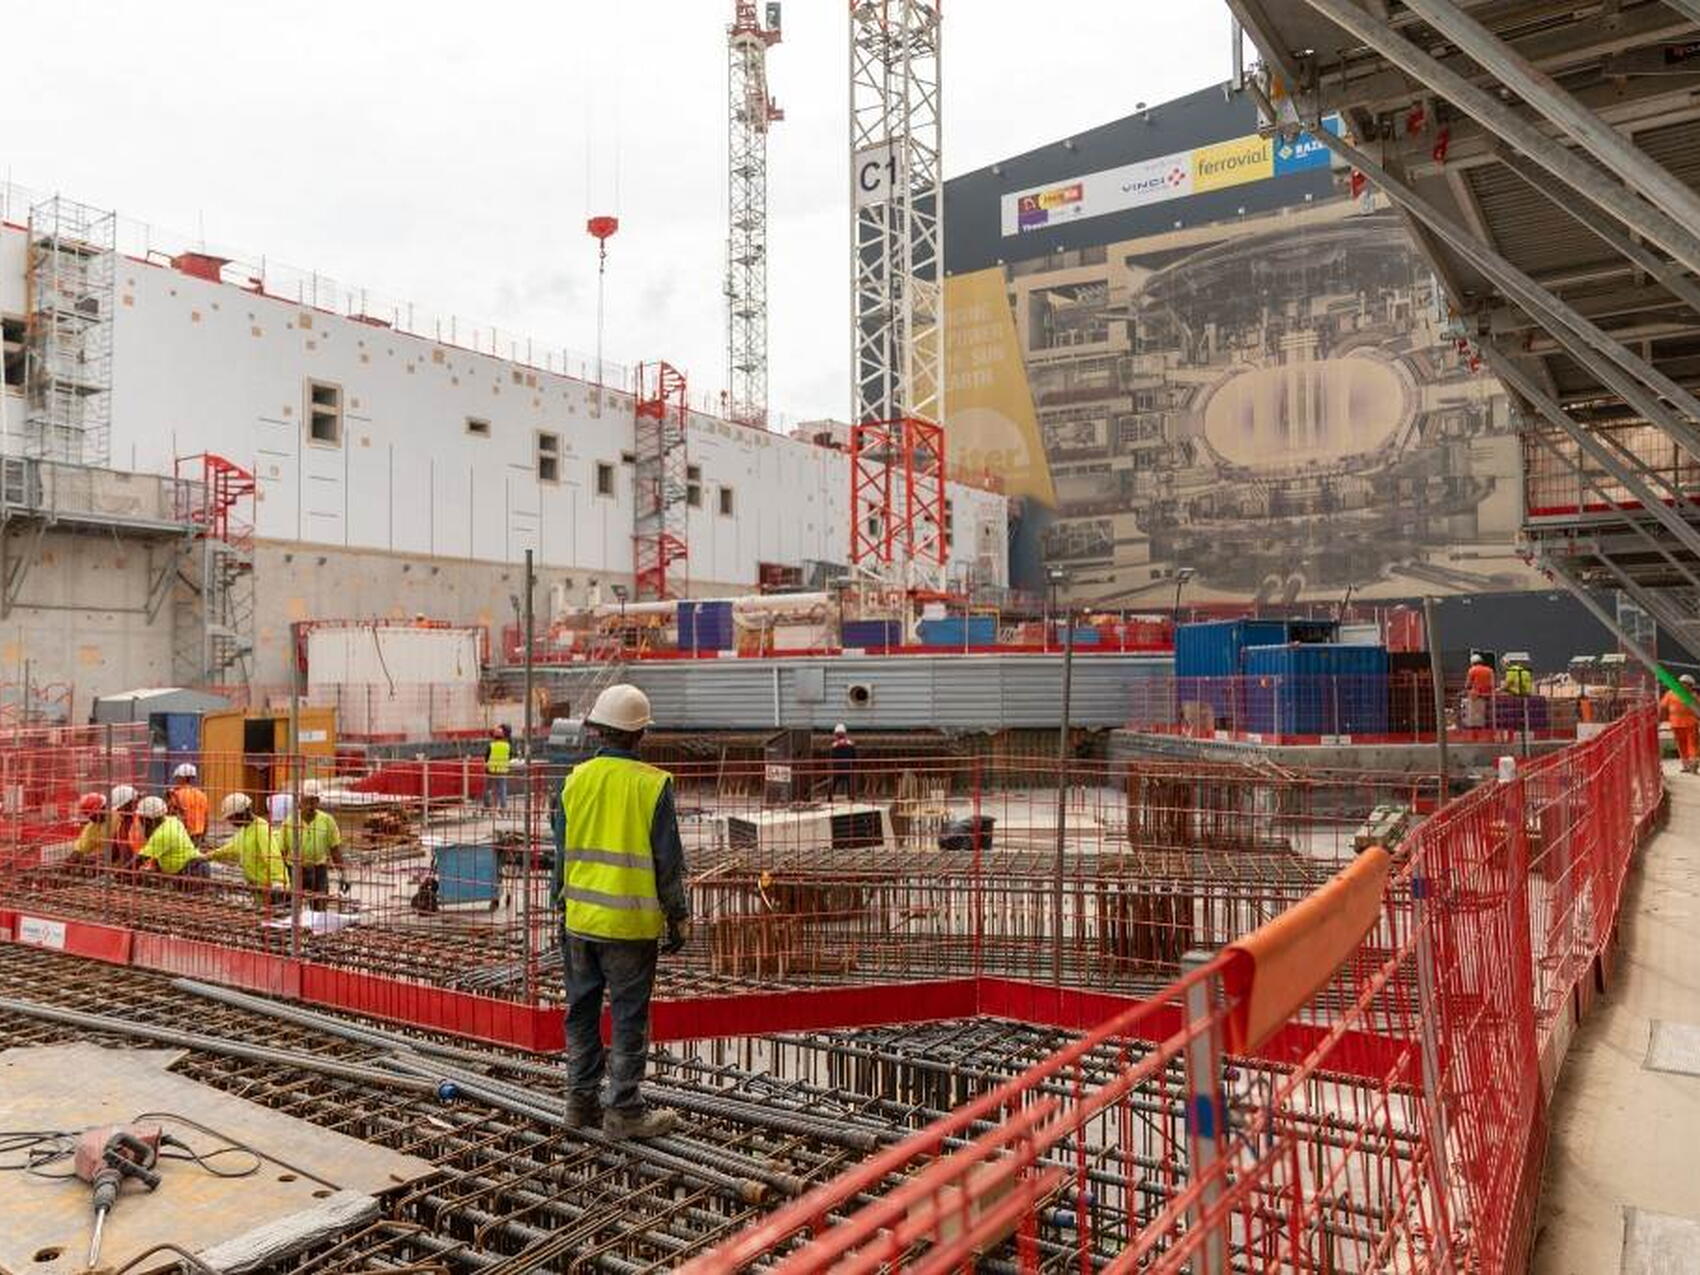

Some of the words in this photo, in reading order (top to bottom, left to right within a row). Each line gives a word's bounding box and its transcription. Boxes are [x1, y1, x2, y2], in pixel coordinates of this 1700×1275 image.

[861, 156, 895, 191] C1
[1198, 145, 1270, 176] ferrovial
[1121, 177, 1165, 192] VINCI
